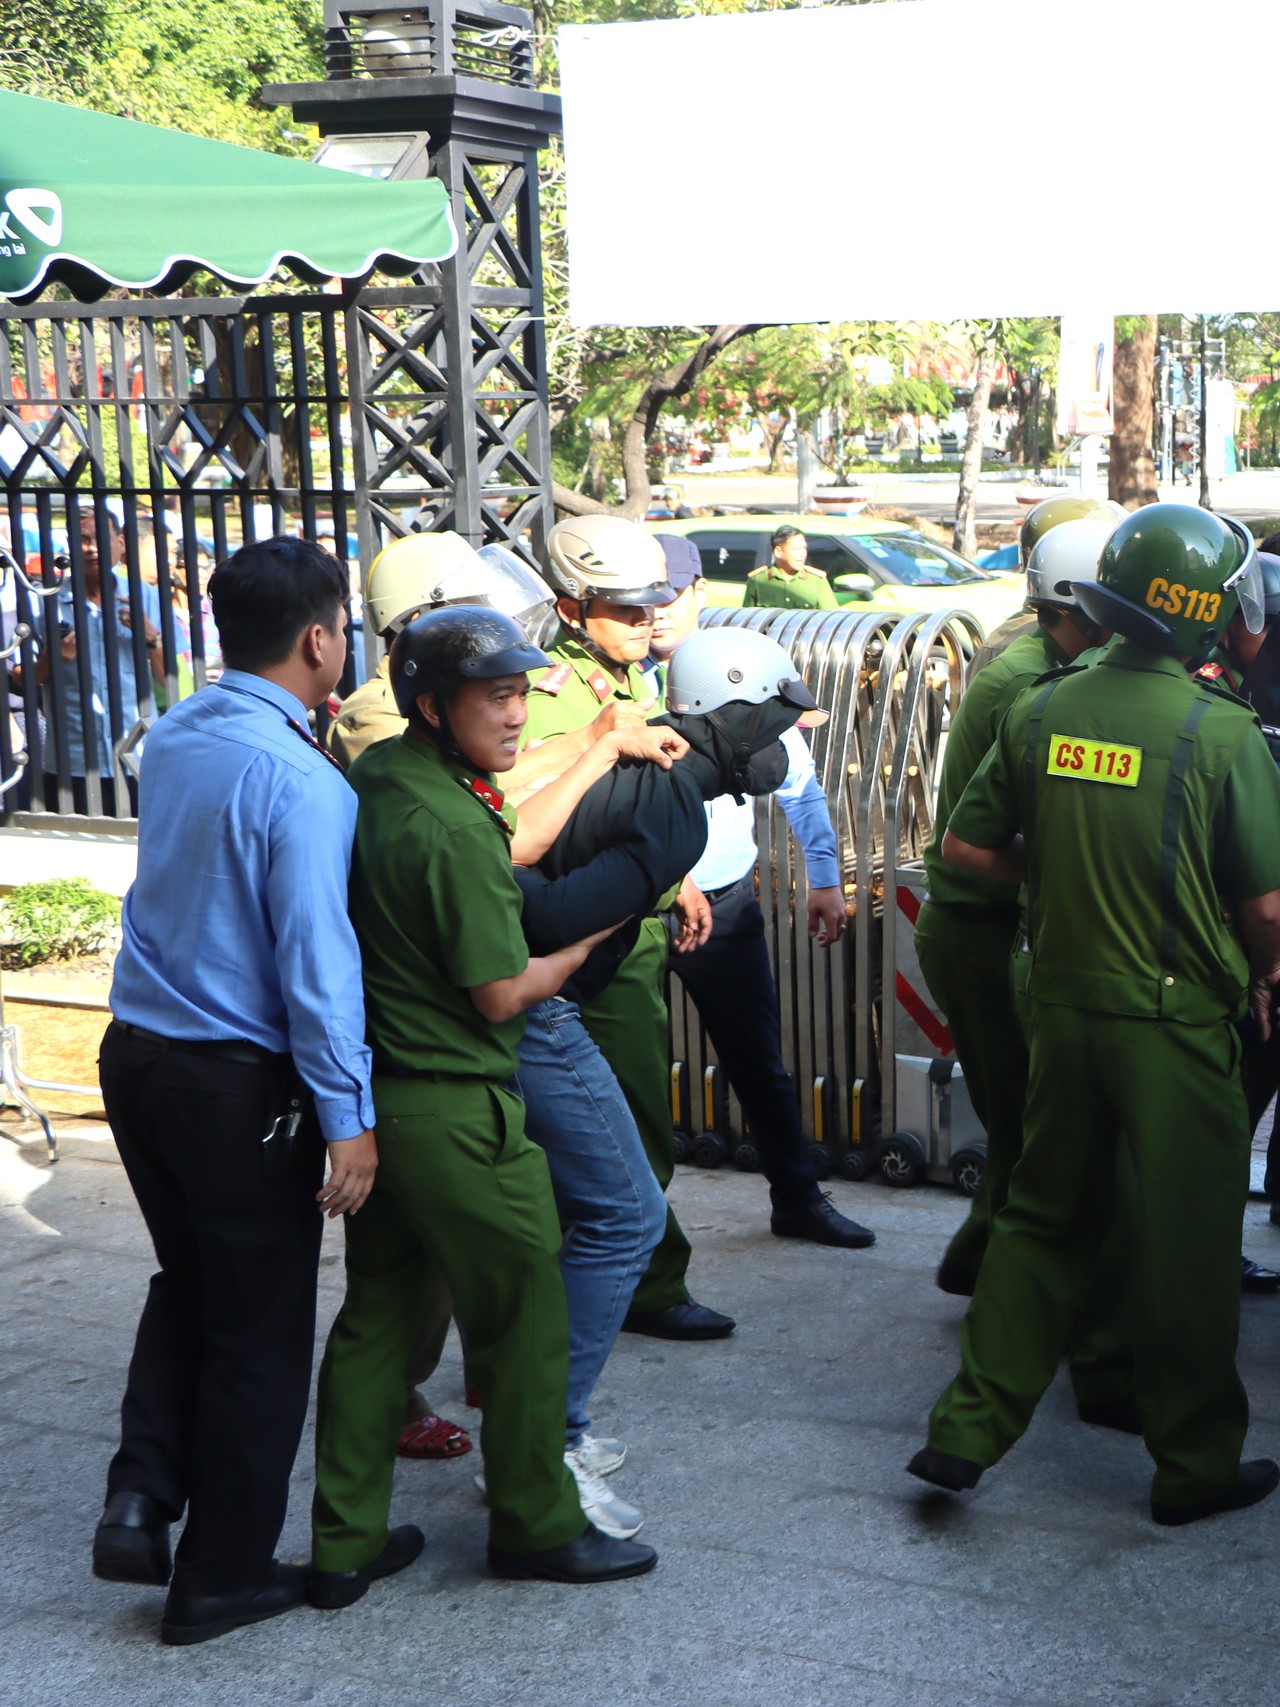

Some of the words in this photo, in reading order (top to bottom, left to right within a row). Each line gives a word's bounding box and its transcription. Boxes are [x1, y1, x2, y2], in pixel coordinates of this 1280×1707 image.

[1146, 578, 1221, 622] CS113
[1056, 743, 1085, 770] CS
[1093, 749, 1132, 778] 113
